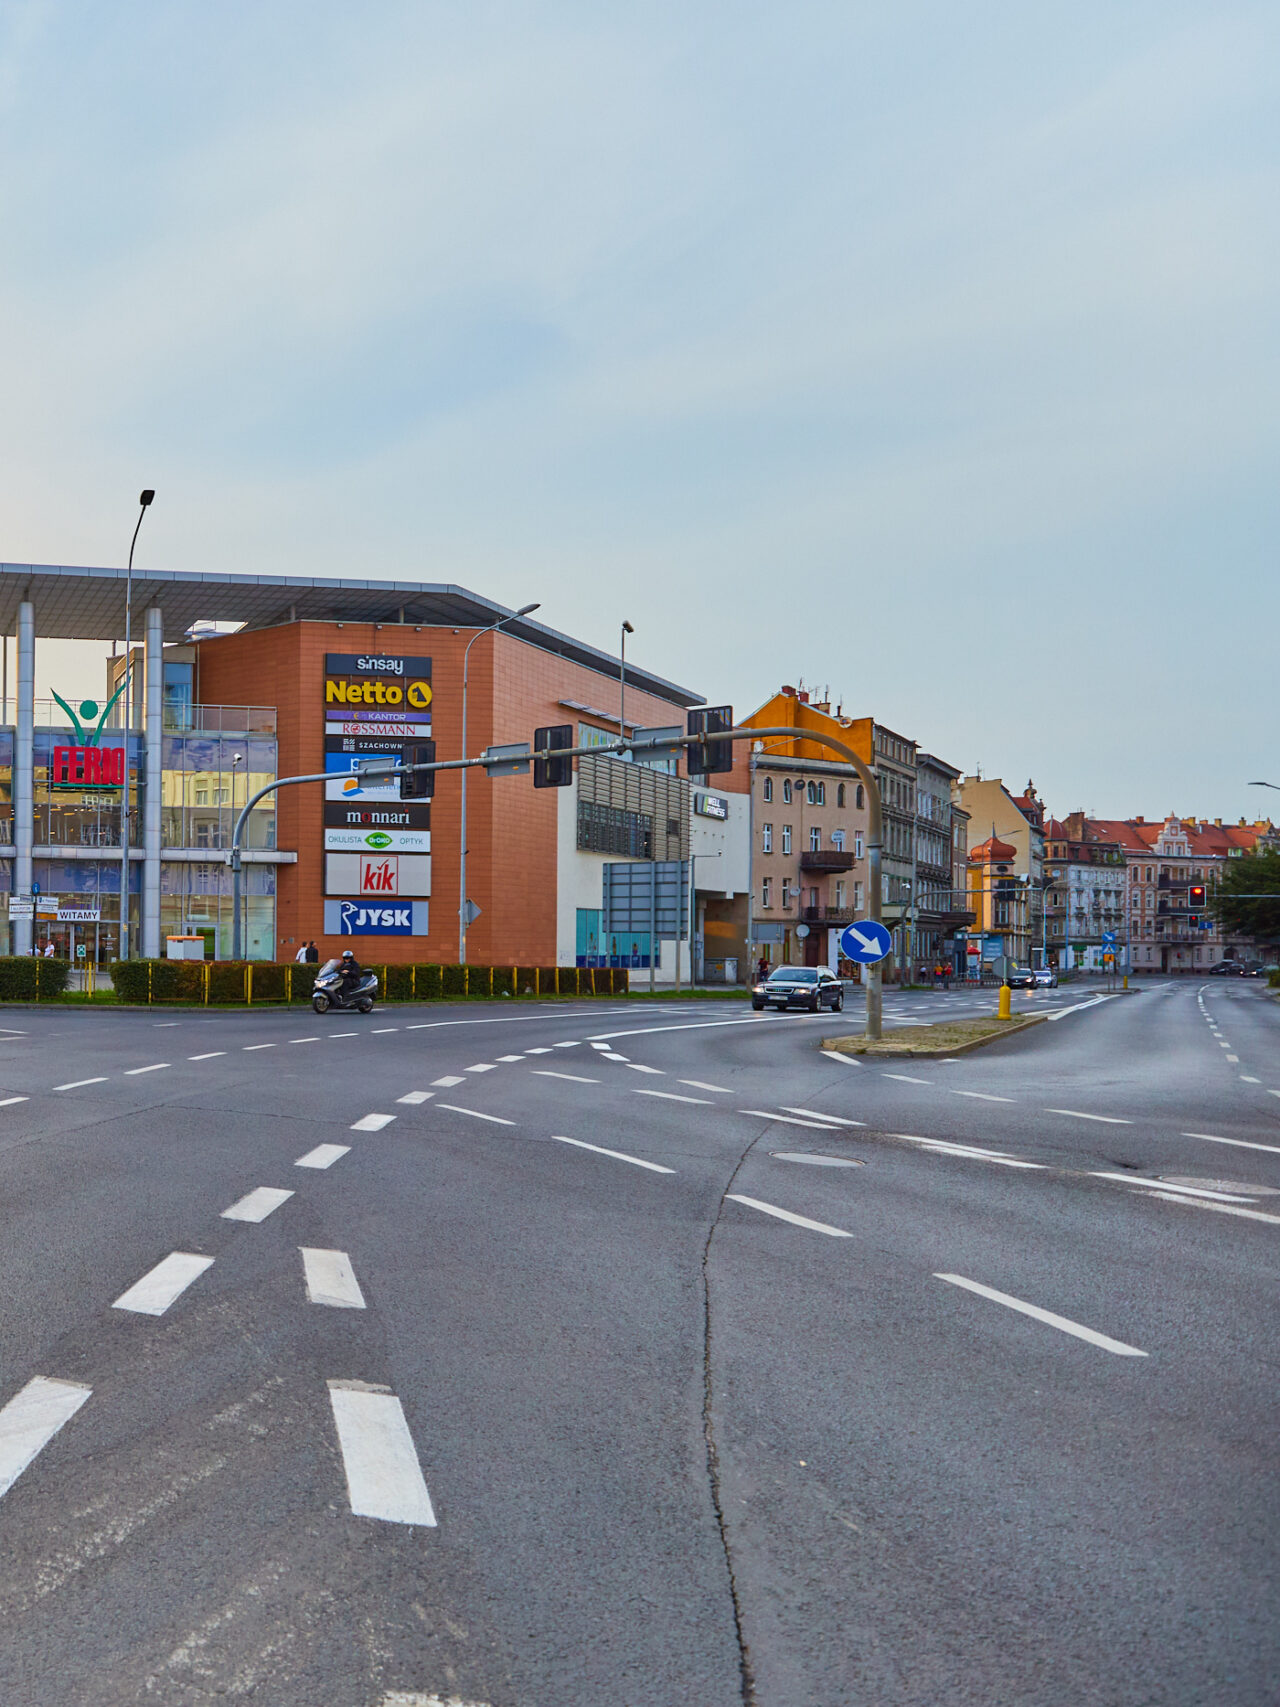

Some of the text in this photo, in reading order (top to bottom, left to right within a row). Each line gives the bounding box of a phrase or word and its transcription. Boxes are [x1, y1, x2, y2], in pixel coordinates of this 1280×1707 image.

[357, 655, 404, 675] sinsay
[326, 681, 403, 705] Netto
[368, 712, 406, 721] KANTOR
[342, 723, 416, 735] ROSSMANN
[53, 745, 125, 786] FERIO
[346, 808, 411, 825] monnari
[59, 911, 98, 920] WITAMY
[355, 908, 411, 927] JYSK
